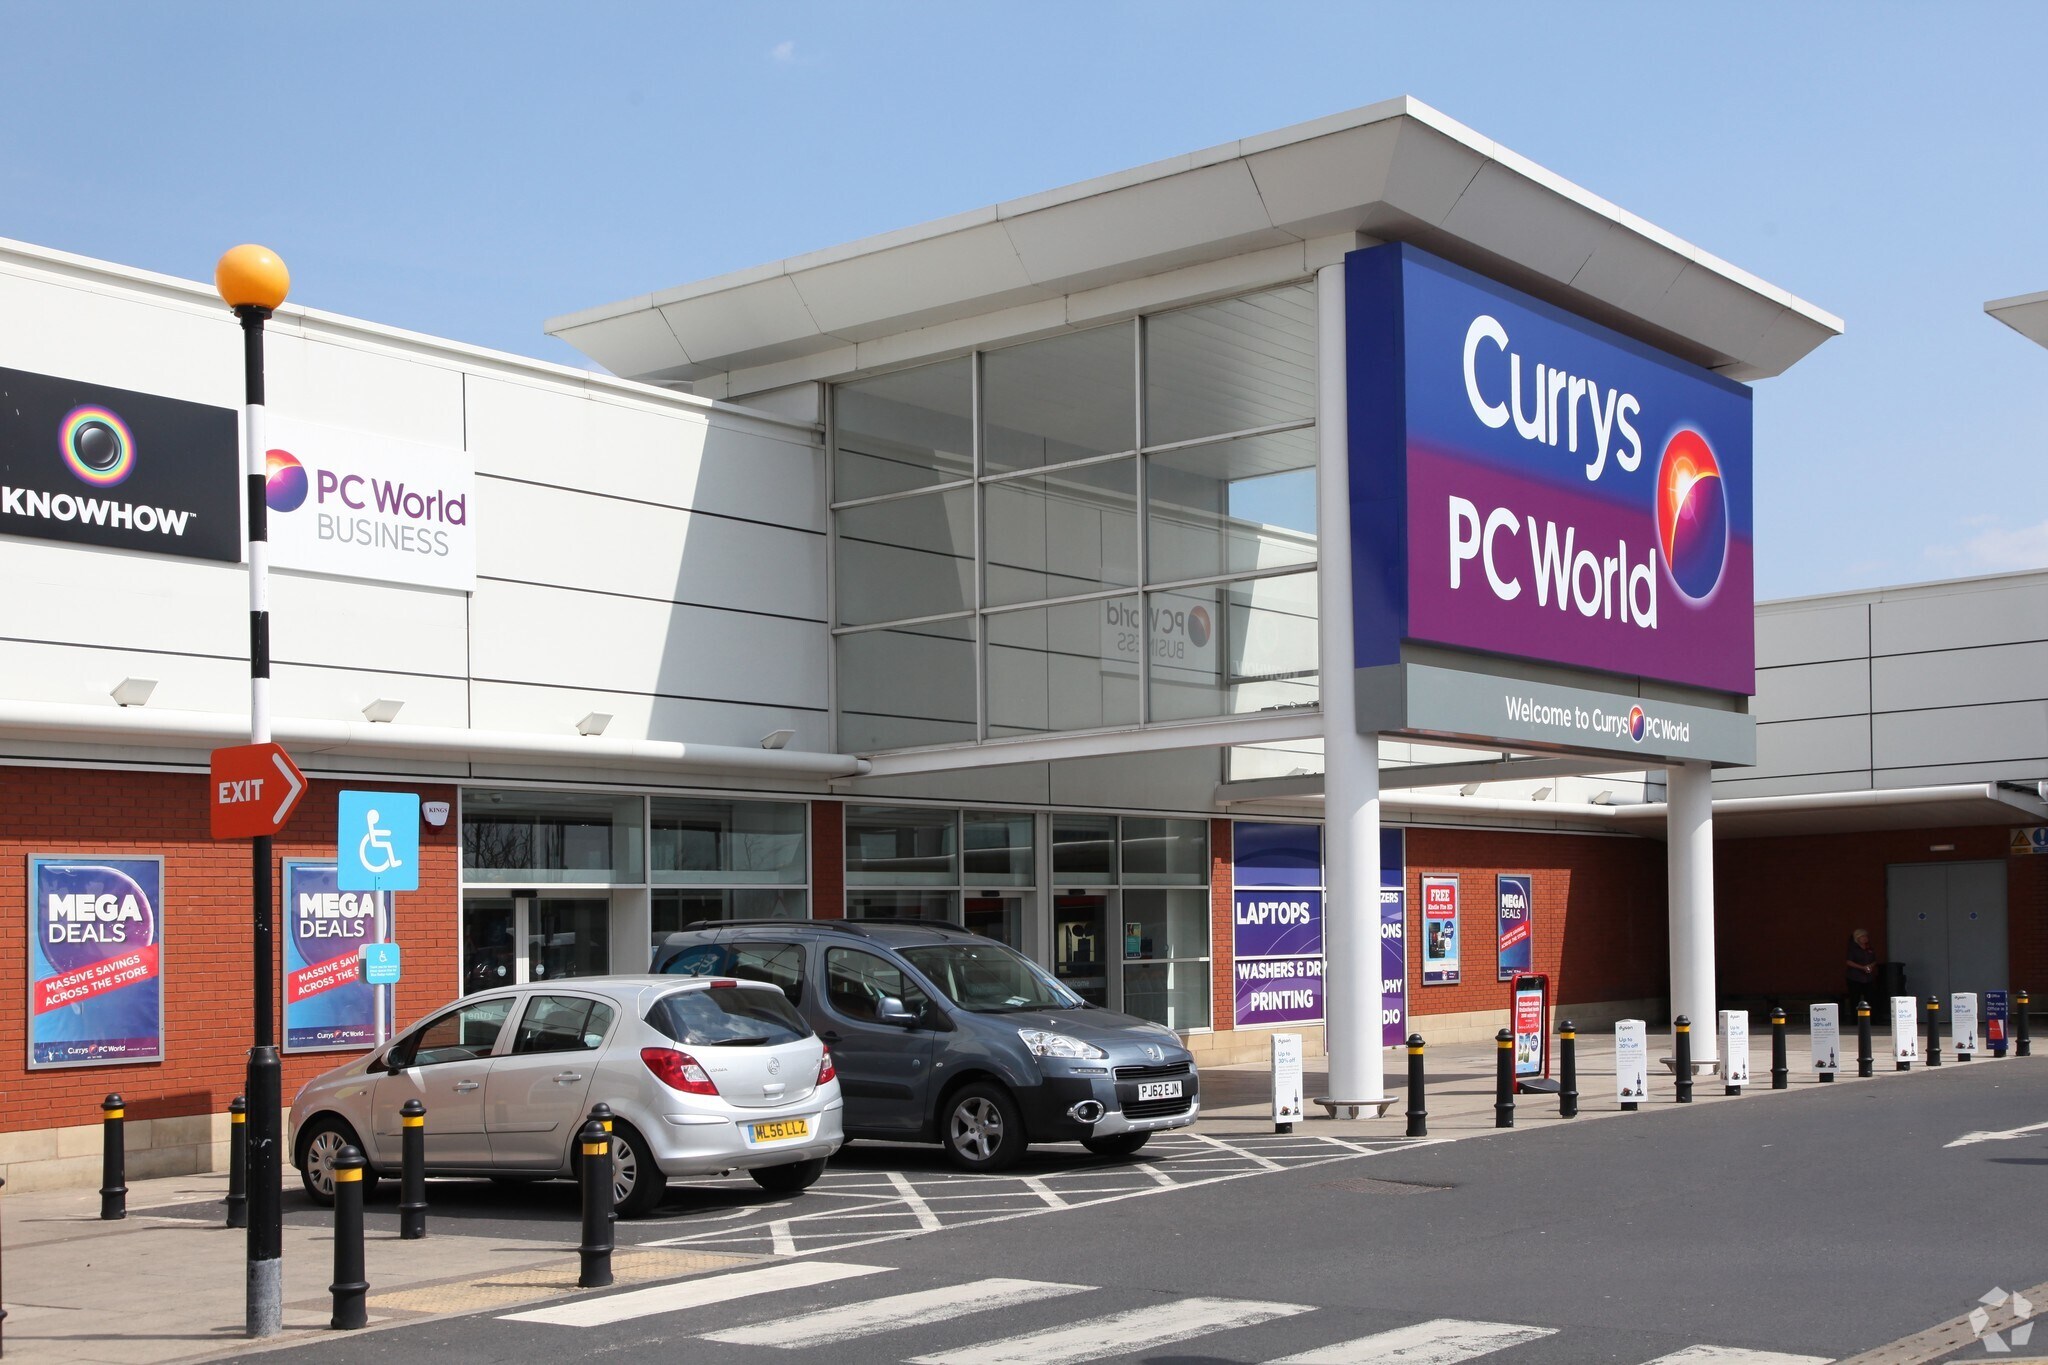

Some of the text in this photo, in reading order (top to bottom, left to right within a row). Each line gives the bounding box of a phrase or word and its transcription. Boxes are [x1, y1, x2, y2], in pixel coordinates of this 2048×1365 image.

[1463, 314, 1642, 481] Currys
[317, 469, 466, 526] PC World
[318, 513, 449, 557] BUSINESS
[1449, 495, 1658, 629] PC World
[1505, 695, 1690, 742] Welcome to Currys PC World
[218, 778, 264, 804] EXIT
[300, 892, 374, 918] MEGA
[1380, 892, 1399, 903] ZERS
[1430, 889, 1450, 901] FREE
[1501, 893, 1525, 909] MEGA
[48, 893, 143, 922] MEGA
[1236, 901, 1310, 925] LAPTOPS
[1501, 909, 1521, 919] DEALS
[48, 924, 126, 943] DEALS
[300, 920, 365, 938] DEALS
[1381, 923, 1402, 938] ONS
[46, 955, 141, 993] MASSIVE SAVINGS
[298, 954, 359, 983] MASSIVE SAVI
[1237, 961, 1294, 979] WASHERS
[1297, 961, 1304, 976] &
[45, 965, 148, 1007] ACROSS THE STORE
[298, 976, 335, 996] ACROSS
[336, 968, 355, 981] THE
[1250, 989, 1313, 1011] PRINTING
[468, 1011, 494, 1020] entry
[1383, 1009, 1400, 1024] DIO
[67, 1047, 88, 1055] Currys
[1142, 1082, 1179, 1098] PJ62 EJN
[755, 1120, 807, 1140] ML56 LLZ
